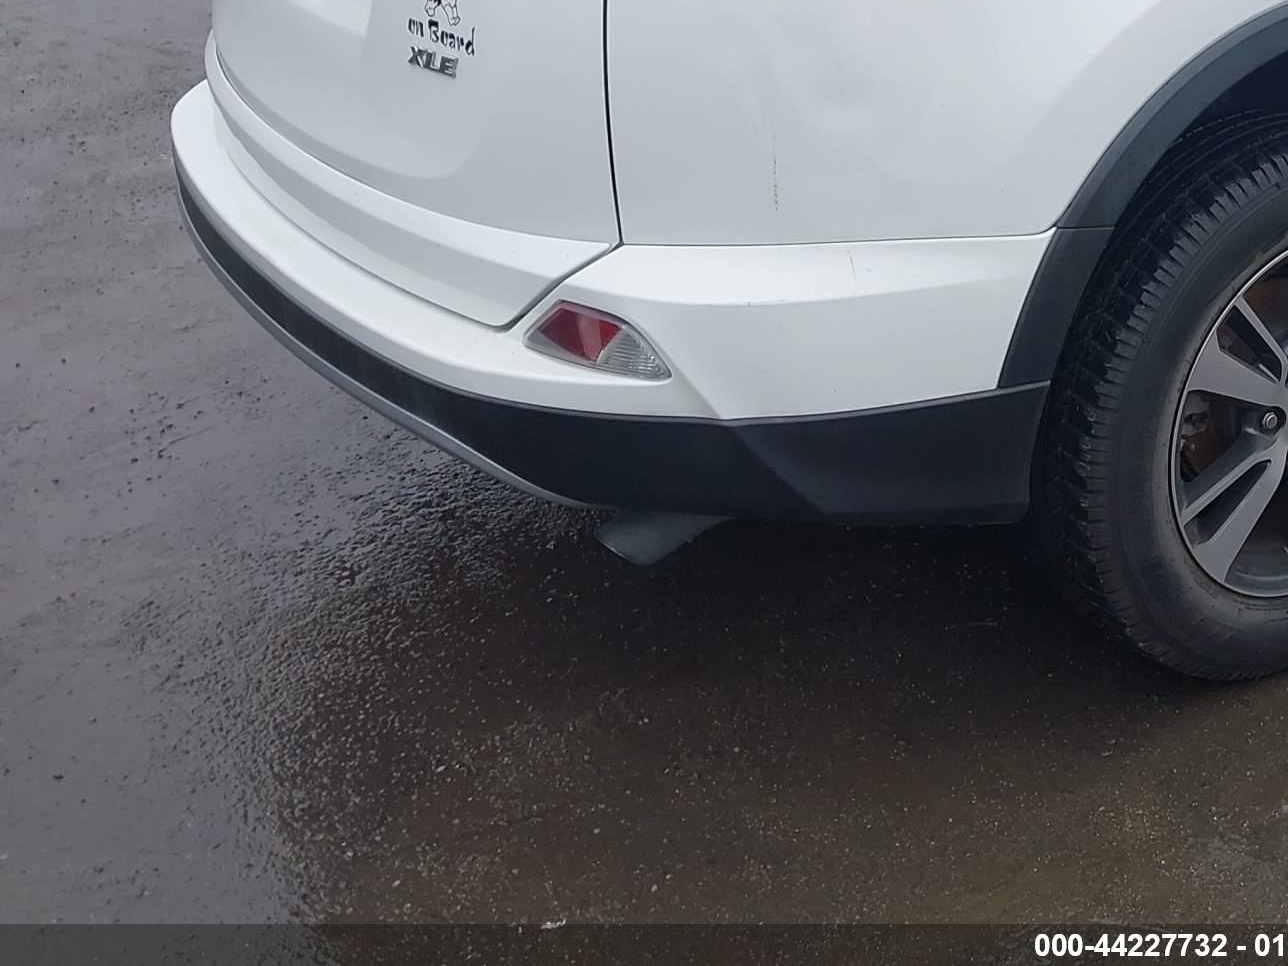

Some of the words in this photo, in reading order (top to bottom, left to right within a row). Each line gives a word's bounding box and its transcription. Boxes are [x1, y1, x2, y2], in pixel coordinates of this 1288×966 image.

[408, 17, 424, 37] on
[428, 19, 475, 56] Board
[407, 45, 459, 78] XLE
